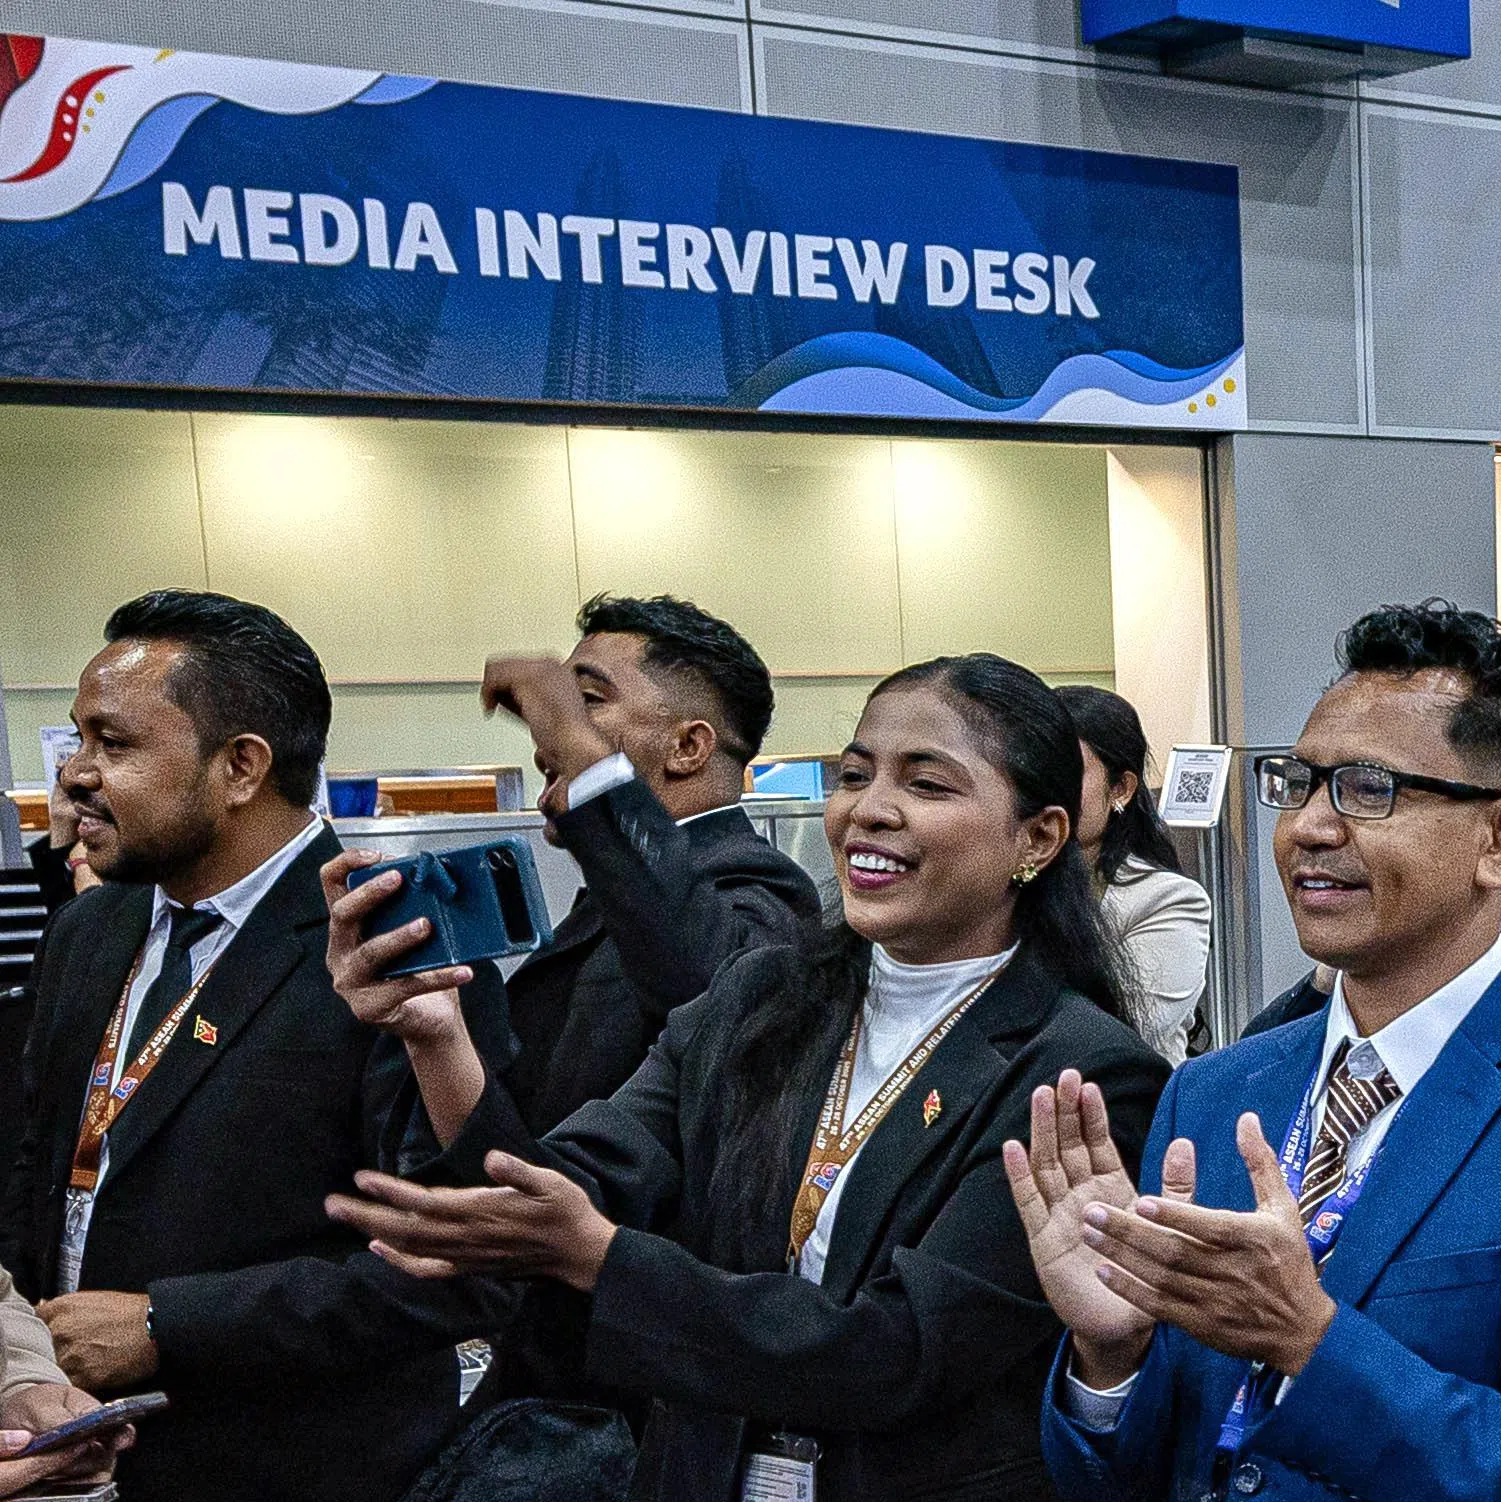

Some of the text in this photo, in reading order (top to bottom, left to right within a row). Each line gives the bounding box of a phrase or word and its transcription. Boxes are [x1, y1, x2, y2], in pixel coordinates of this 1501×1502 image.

[161, 181, 1100, 318] MEDIA INTERVIEW DESK
[852, 1100, 881, 1131] ASEAN
[877, 1065, 910, 1102] SUMMIT
[907, 1046, 928, 1068] AND
[925, 1010, 961, 1050] RELATED
[1283, 1128, 1301, 1163] ASEAN
